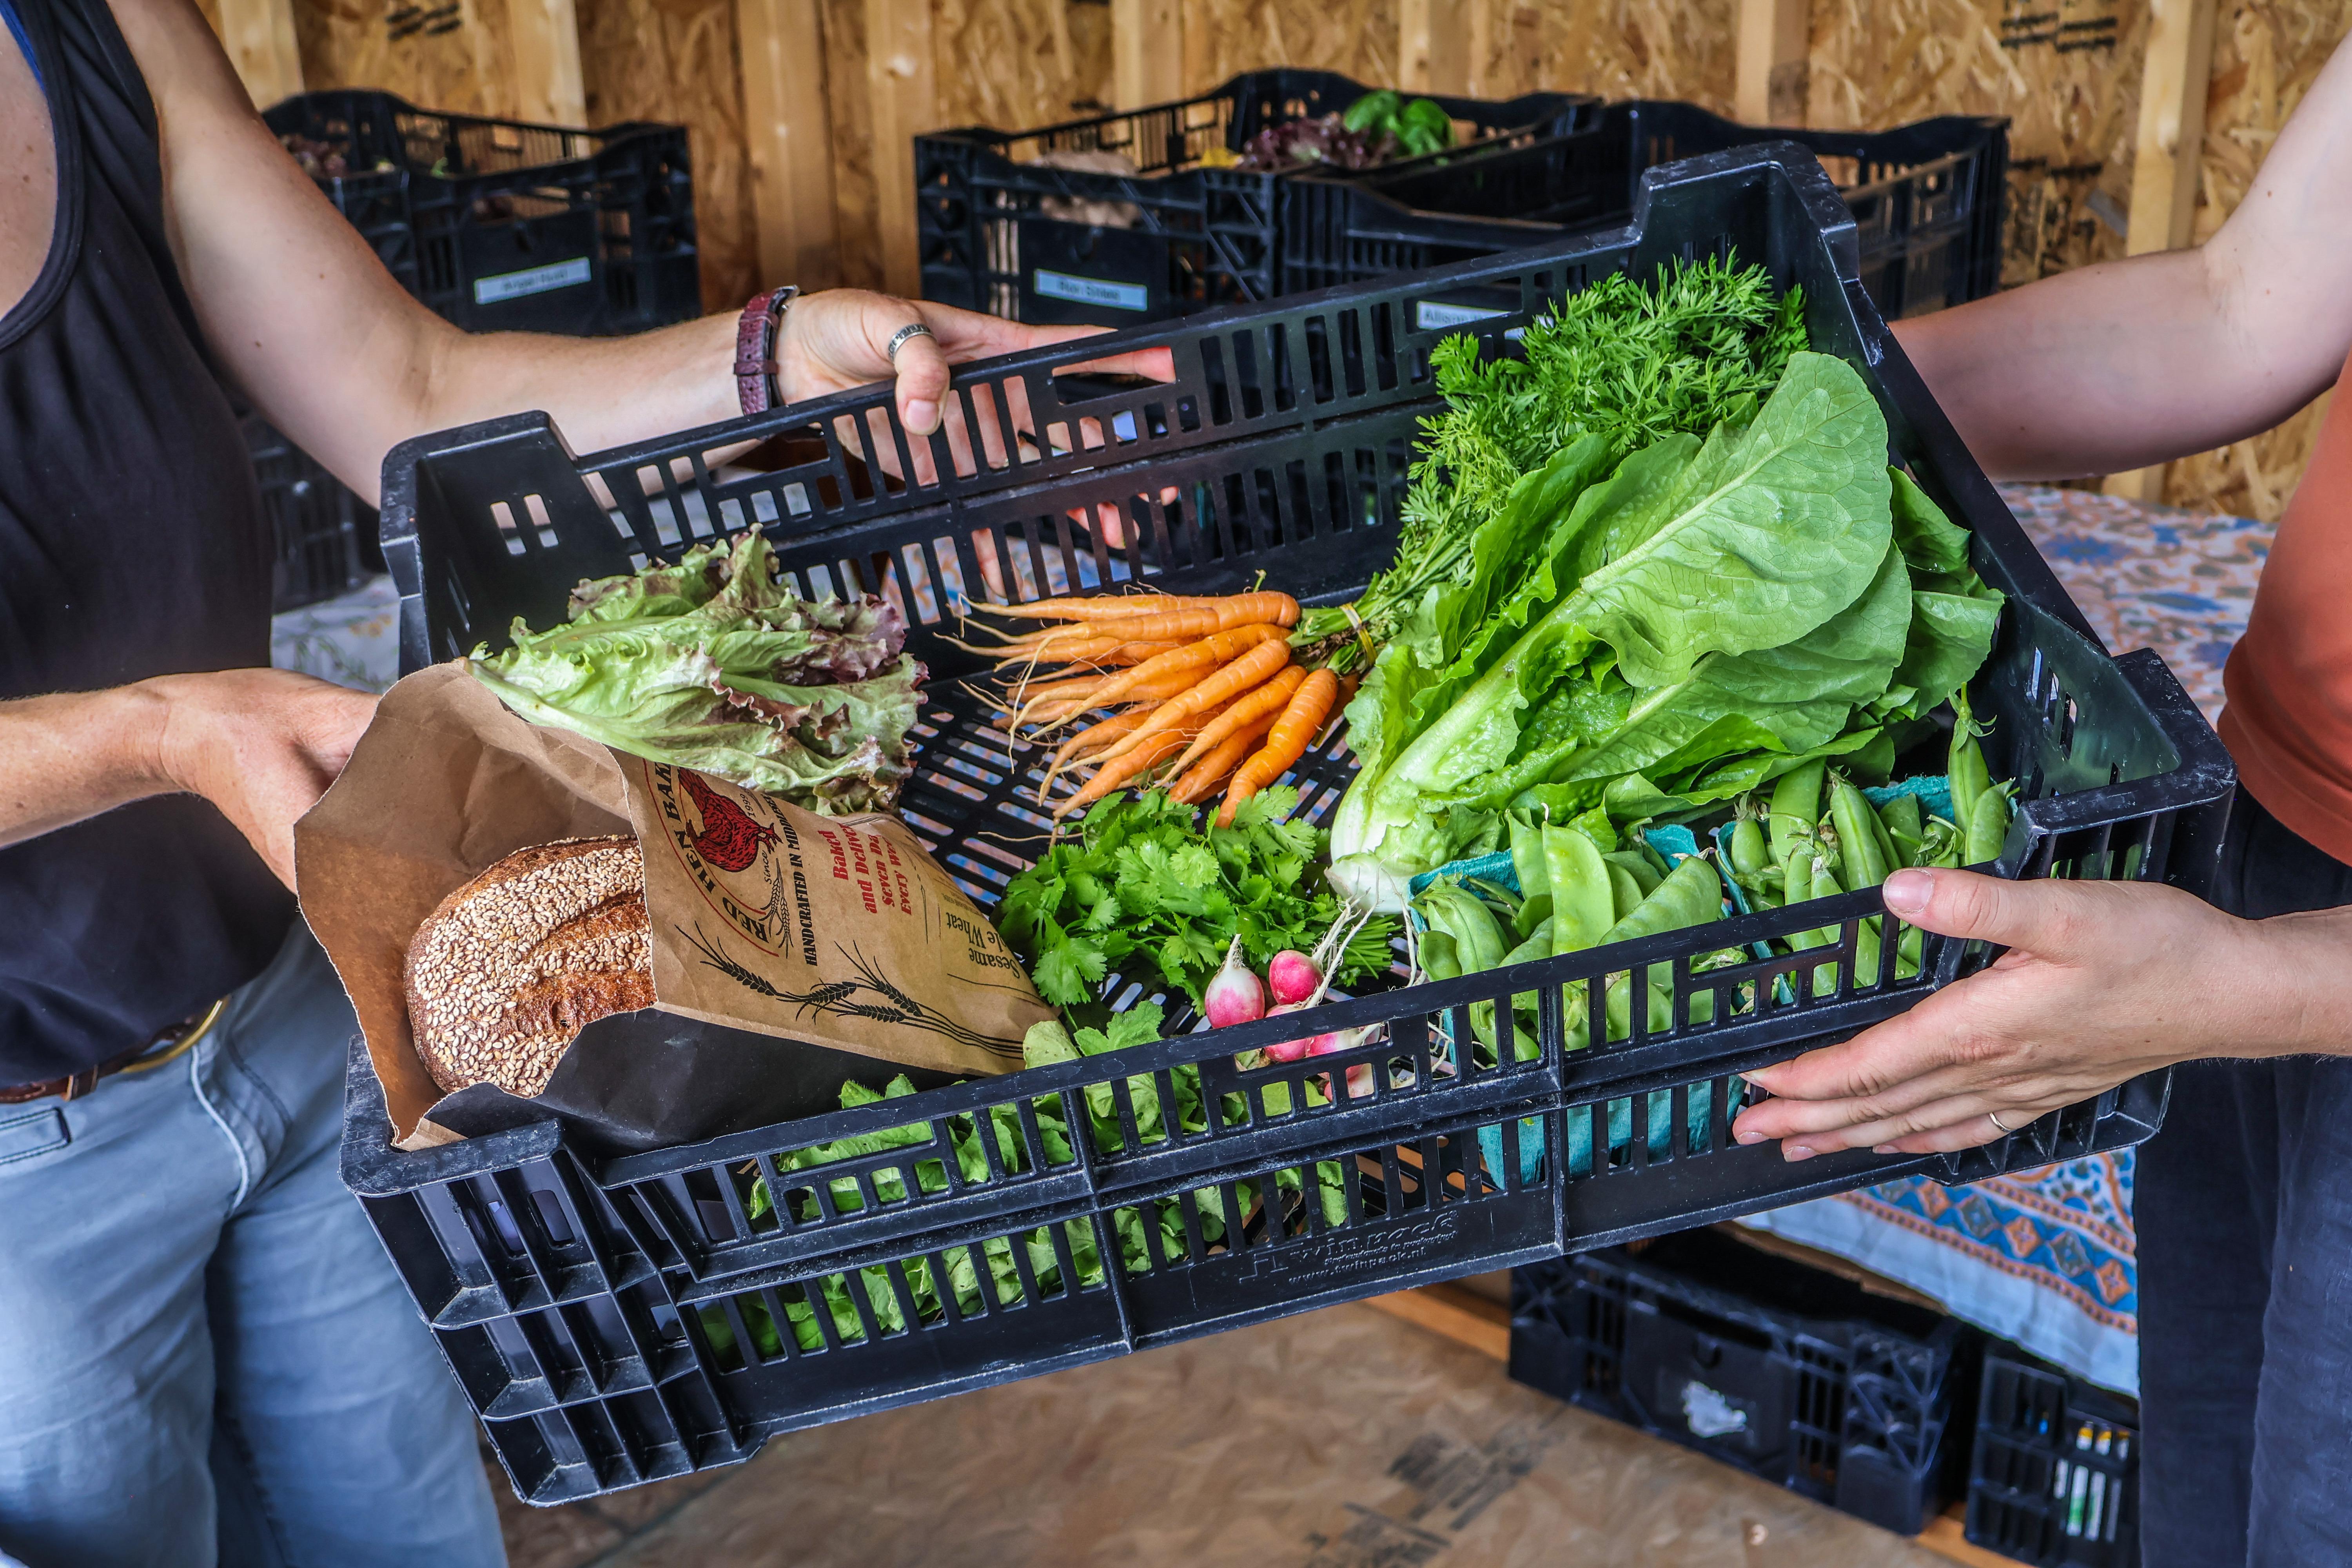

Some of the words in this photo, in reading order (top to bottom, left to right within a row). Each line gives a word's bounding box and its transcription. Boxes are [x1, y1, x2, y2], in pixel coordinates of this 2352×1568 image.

[654, 762, 682, 823] BAK
[740, 793, 756, 818] 1999
[674, 830, 716, 894] HEN
[789, 853, 803, 868] IN
[817, 830, 849, 880] Baked
[867, 834, 883, 857] Da
[762, 850, 772, 884] Since
[875, 860, 895, 907] Seven
[857, 879, 878, 914] and
[894, 870, 912, 916] Every
[722, 897, 769, 944] RED
[793, 871, 818, 966] HANDCRAFTED
[946, 912, 987, 949] Wheat
[968, 947, 1020, 979] Sesame
